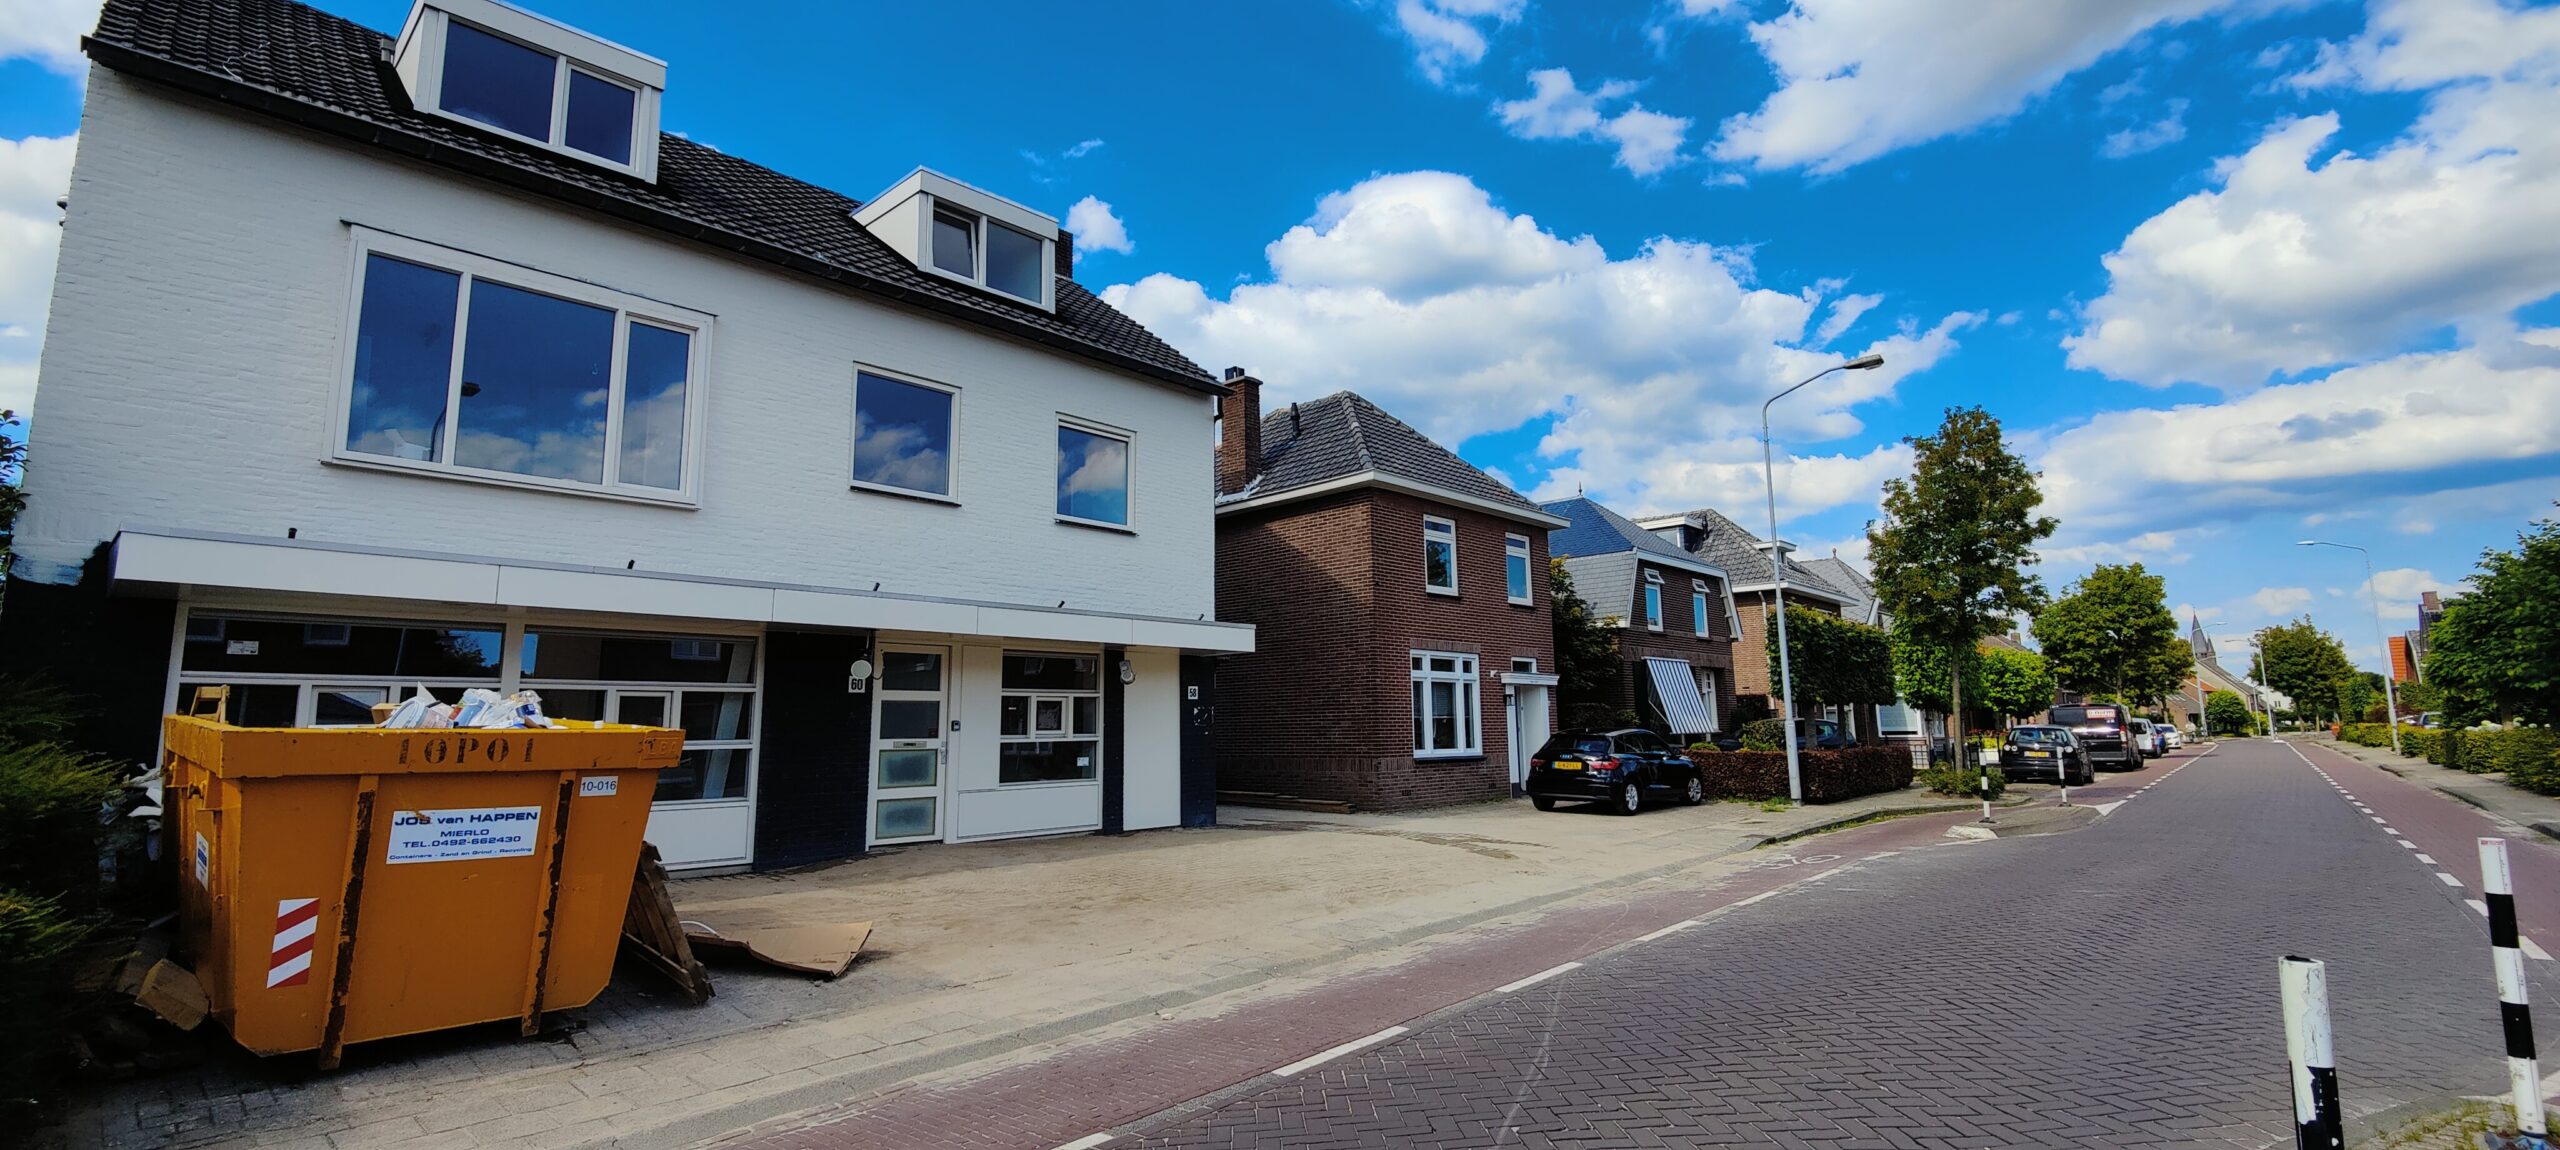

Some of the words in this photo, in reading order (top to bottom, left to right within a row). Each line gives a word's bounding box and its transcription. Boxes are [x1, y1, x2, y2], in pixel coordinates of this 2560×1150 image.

[851, 678, 863, 690] 60
[1189, 688, 1197, 697] 58
[581, 781, 616, 791] 10-016
[395, 816, 431, 826] JOS
[437, 816, 464, 824] van
[470, 812, 538, 823] HAPPEN
[440, 829, 490, 838] MIERLO
